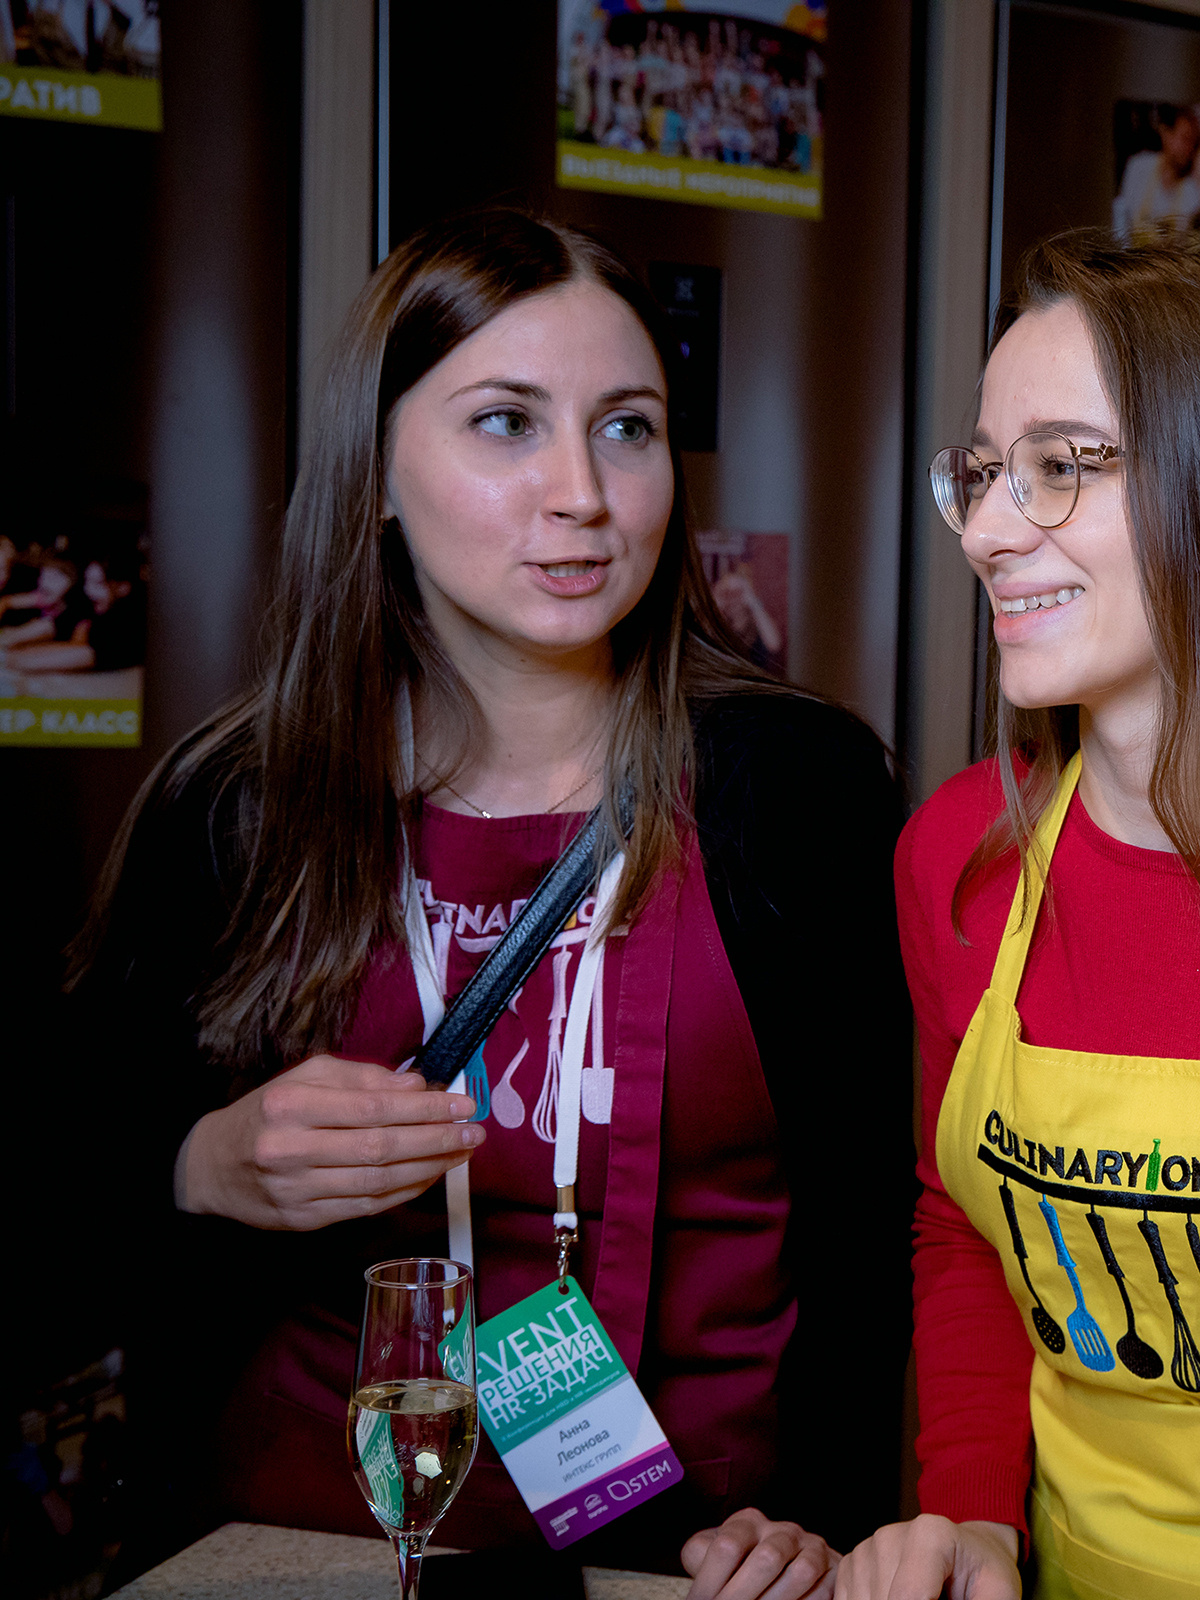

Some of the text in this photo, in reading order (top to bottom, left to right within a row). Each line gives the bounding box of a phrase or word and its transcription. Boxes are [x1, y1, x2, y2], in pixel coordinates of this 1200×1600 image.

[480, 1327, 599, 1407] РЕШЕНИЯ
[557, 1429, 610, 1466] Леонова
[558, 1419, 591, 1443] Анна
